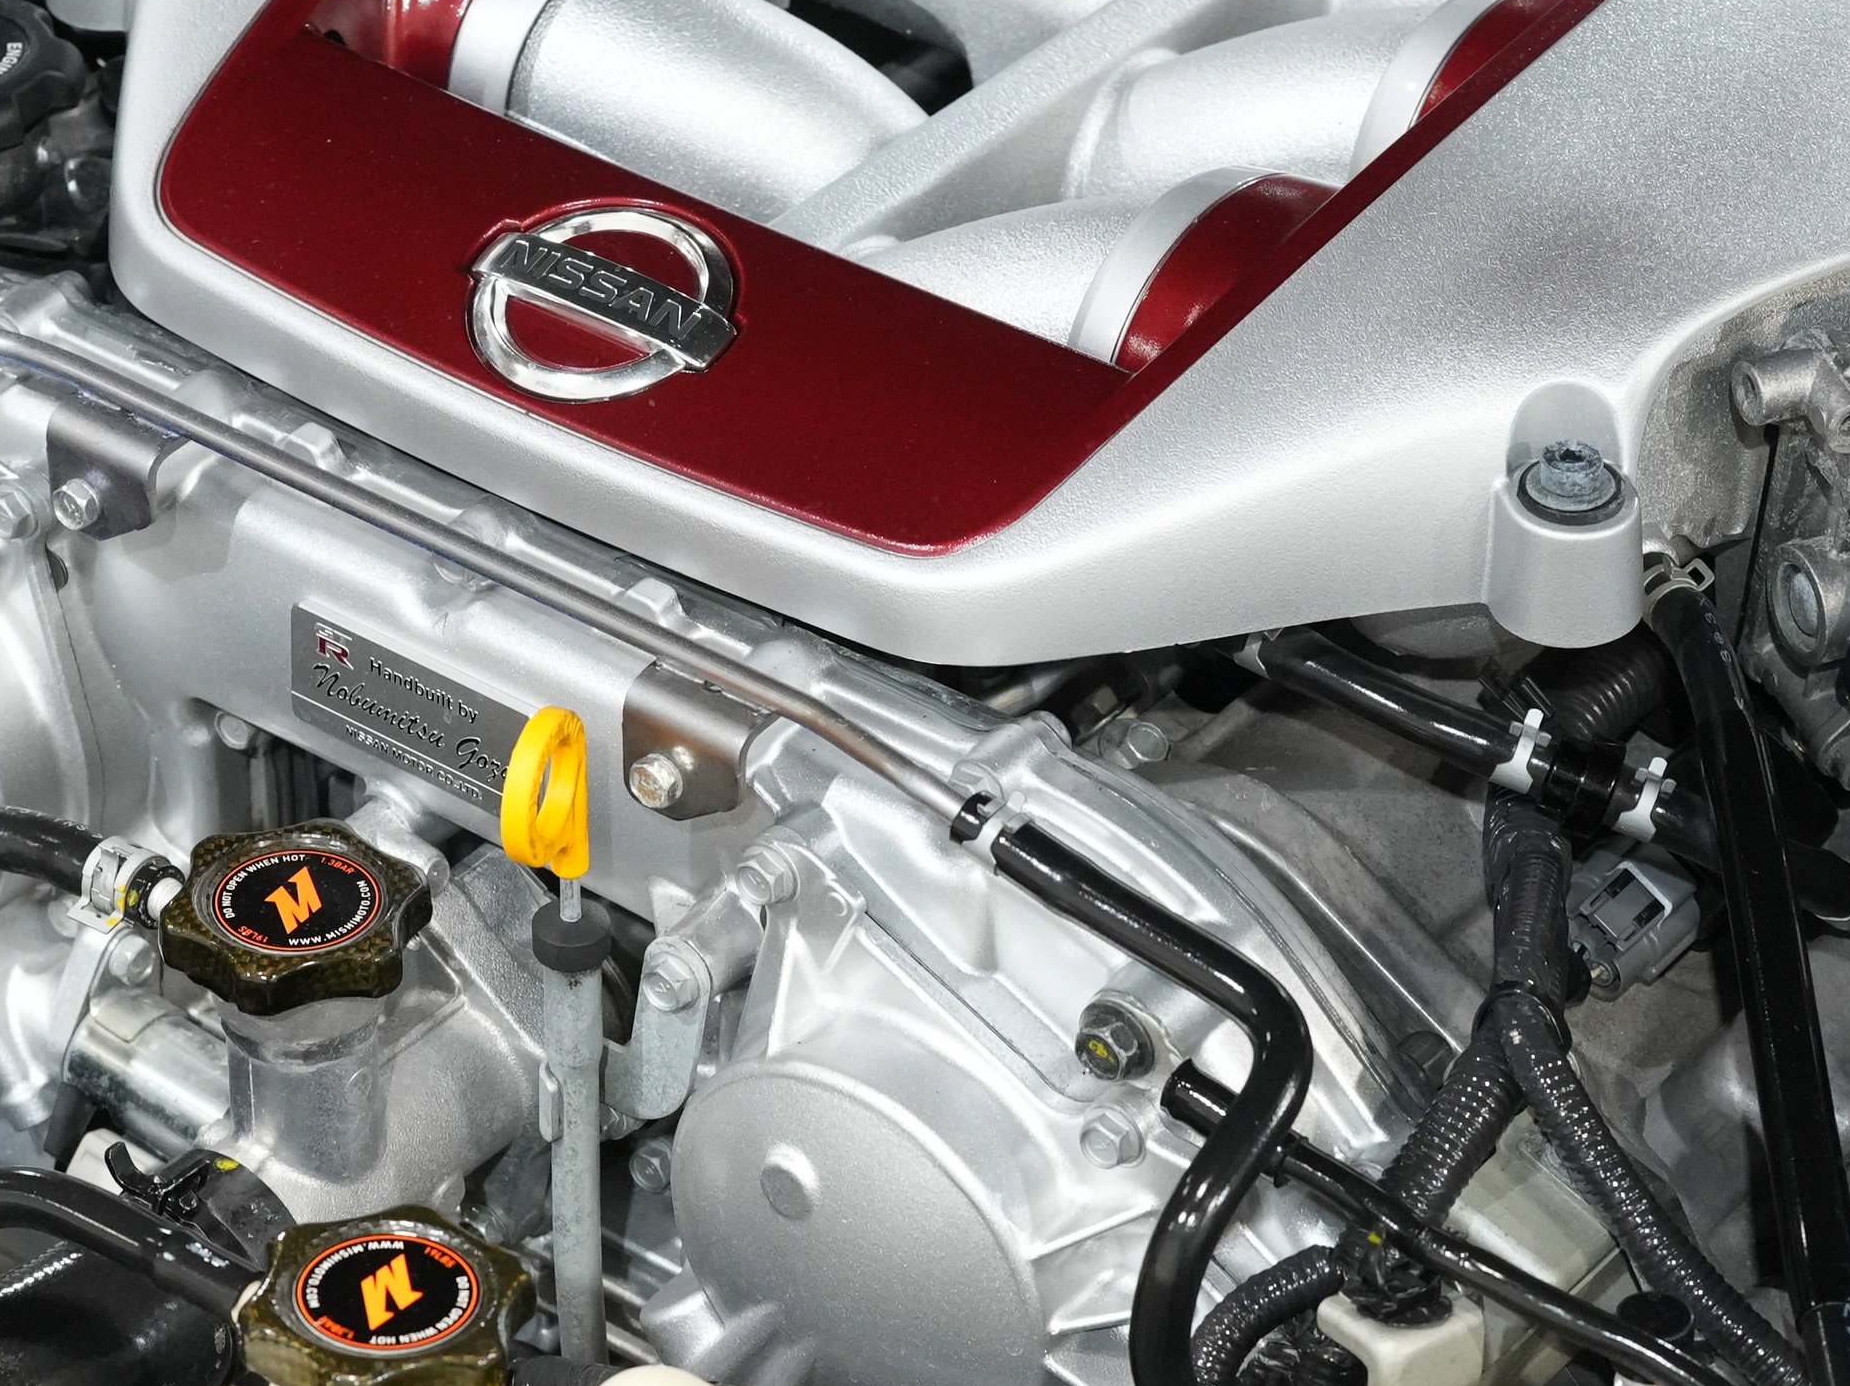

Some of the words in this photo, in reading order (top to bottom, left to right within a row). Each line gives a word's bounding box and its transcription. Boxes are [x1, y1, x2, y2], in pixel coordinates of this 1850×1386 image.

[497, 239, 702, 341] NISSAN
[369, 656, 455, 709] Handbuilt
[457, 699, 479, 724] by
[312, 663, 446, 748] Nobumitsu
[345, 724, 389, 755] NISSAN
[392, 747, 434, 776] MOTOR
[245, 855, 280, 873] WHEN
[282, 854, 306, 863] HOT
[320, 856, 356, 875] 1.3BAR
[226, 870, 248, 891] OPEN
[221, 891, 233, 908] NOT
[223, 907, 236, 919] DO
[288, 880, 372, 946] WWW.MISHIMOTO.COM
[237, 925, 269, 943] 19LBS
[305, 1240, 405, 1309] WWW.MISHIMOTO.COM
[435, 1307, 464, 1332] OPEN
[368, 1334, 397, 1346] HOT
[399, 1325, 439, 1345] WHEN
